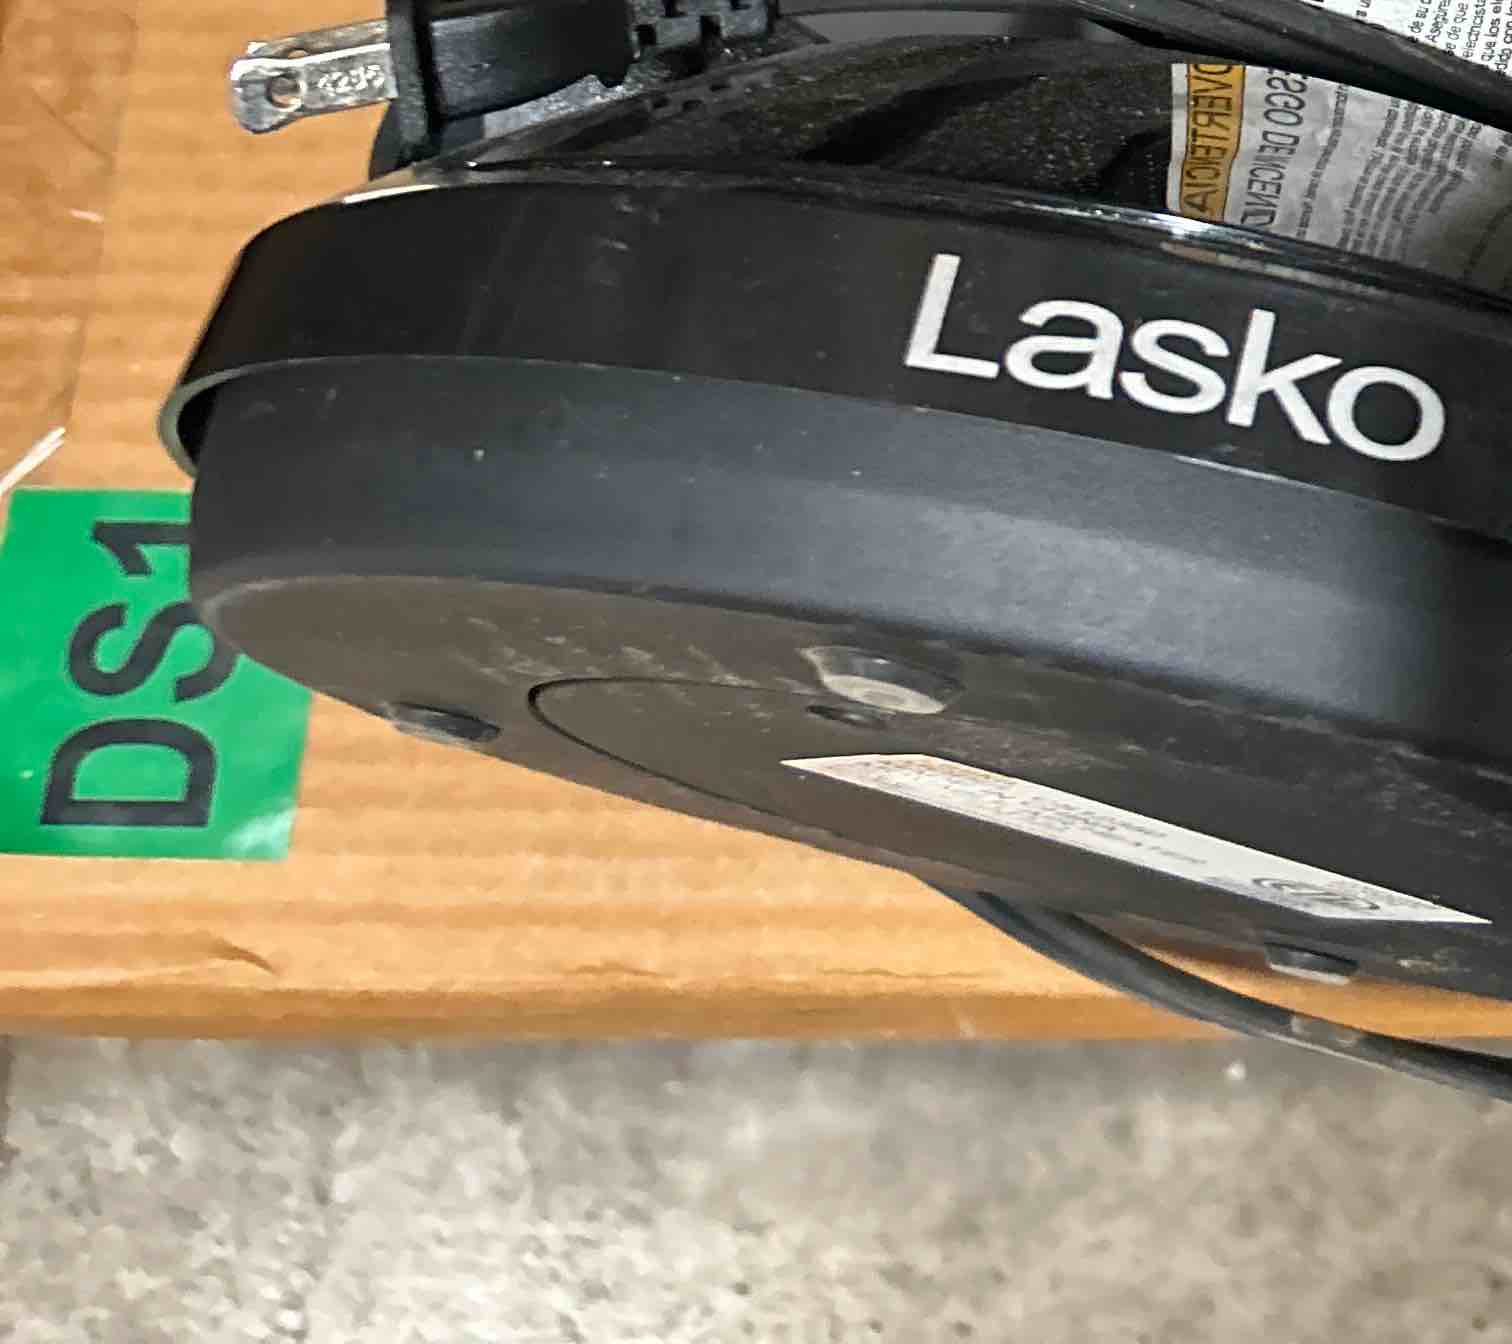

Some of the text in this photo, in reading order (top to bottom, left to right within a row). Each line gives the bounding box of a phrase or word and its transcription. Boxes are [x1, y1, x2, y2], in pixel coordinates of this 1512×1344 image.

[1453, 2, 1470, 24] que
[1409, 19, 1422, 33] de
[1447, 24, 1462, 41] de
[1485, 16, 1502, 39] los
[1479, 39, 1497, 62] que
[903, 253, 1447, 462] Lasko
[39, 520, 243, 827] DS1
